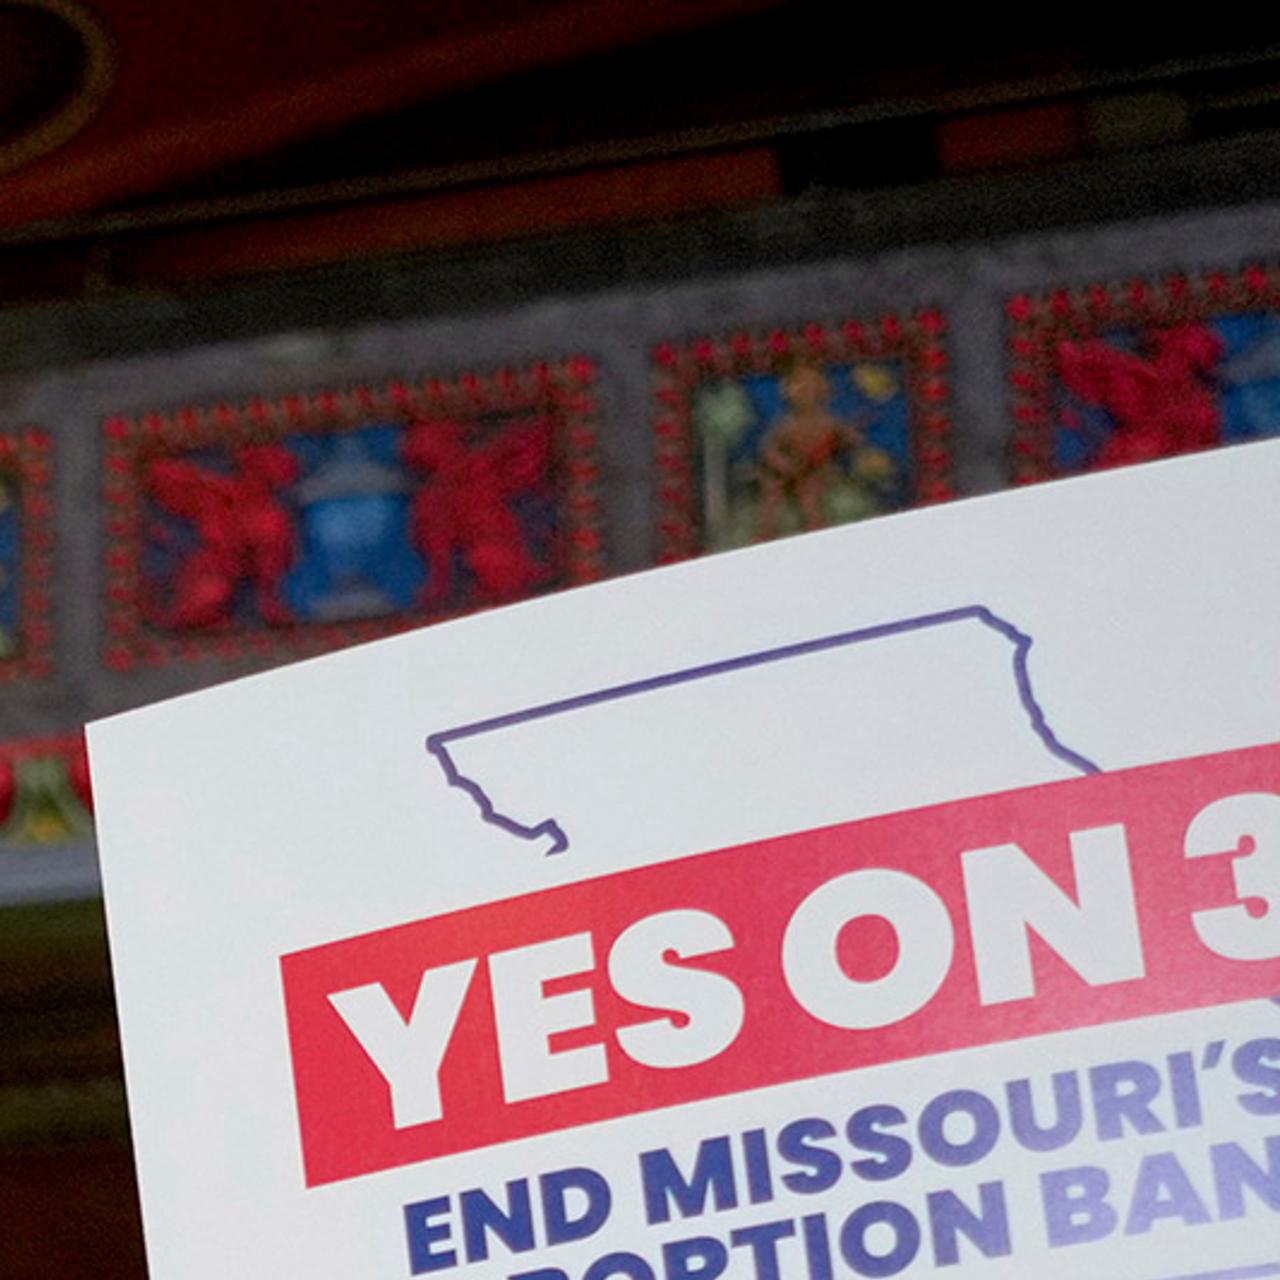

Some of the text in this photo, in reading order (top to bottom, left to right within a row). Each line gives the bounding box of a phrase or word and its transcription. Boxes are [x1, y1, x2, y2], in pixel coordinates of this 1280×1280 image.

[326, 792, 1280, 1131] YES ON 3
[403, 1036, 1280, 1276] END MISSOURI'S
[1040, 1134, 1280, 1250] BAN
